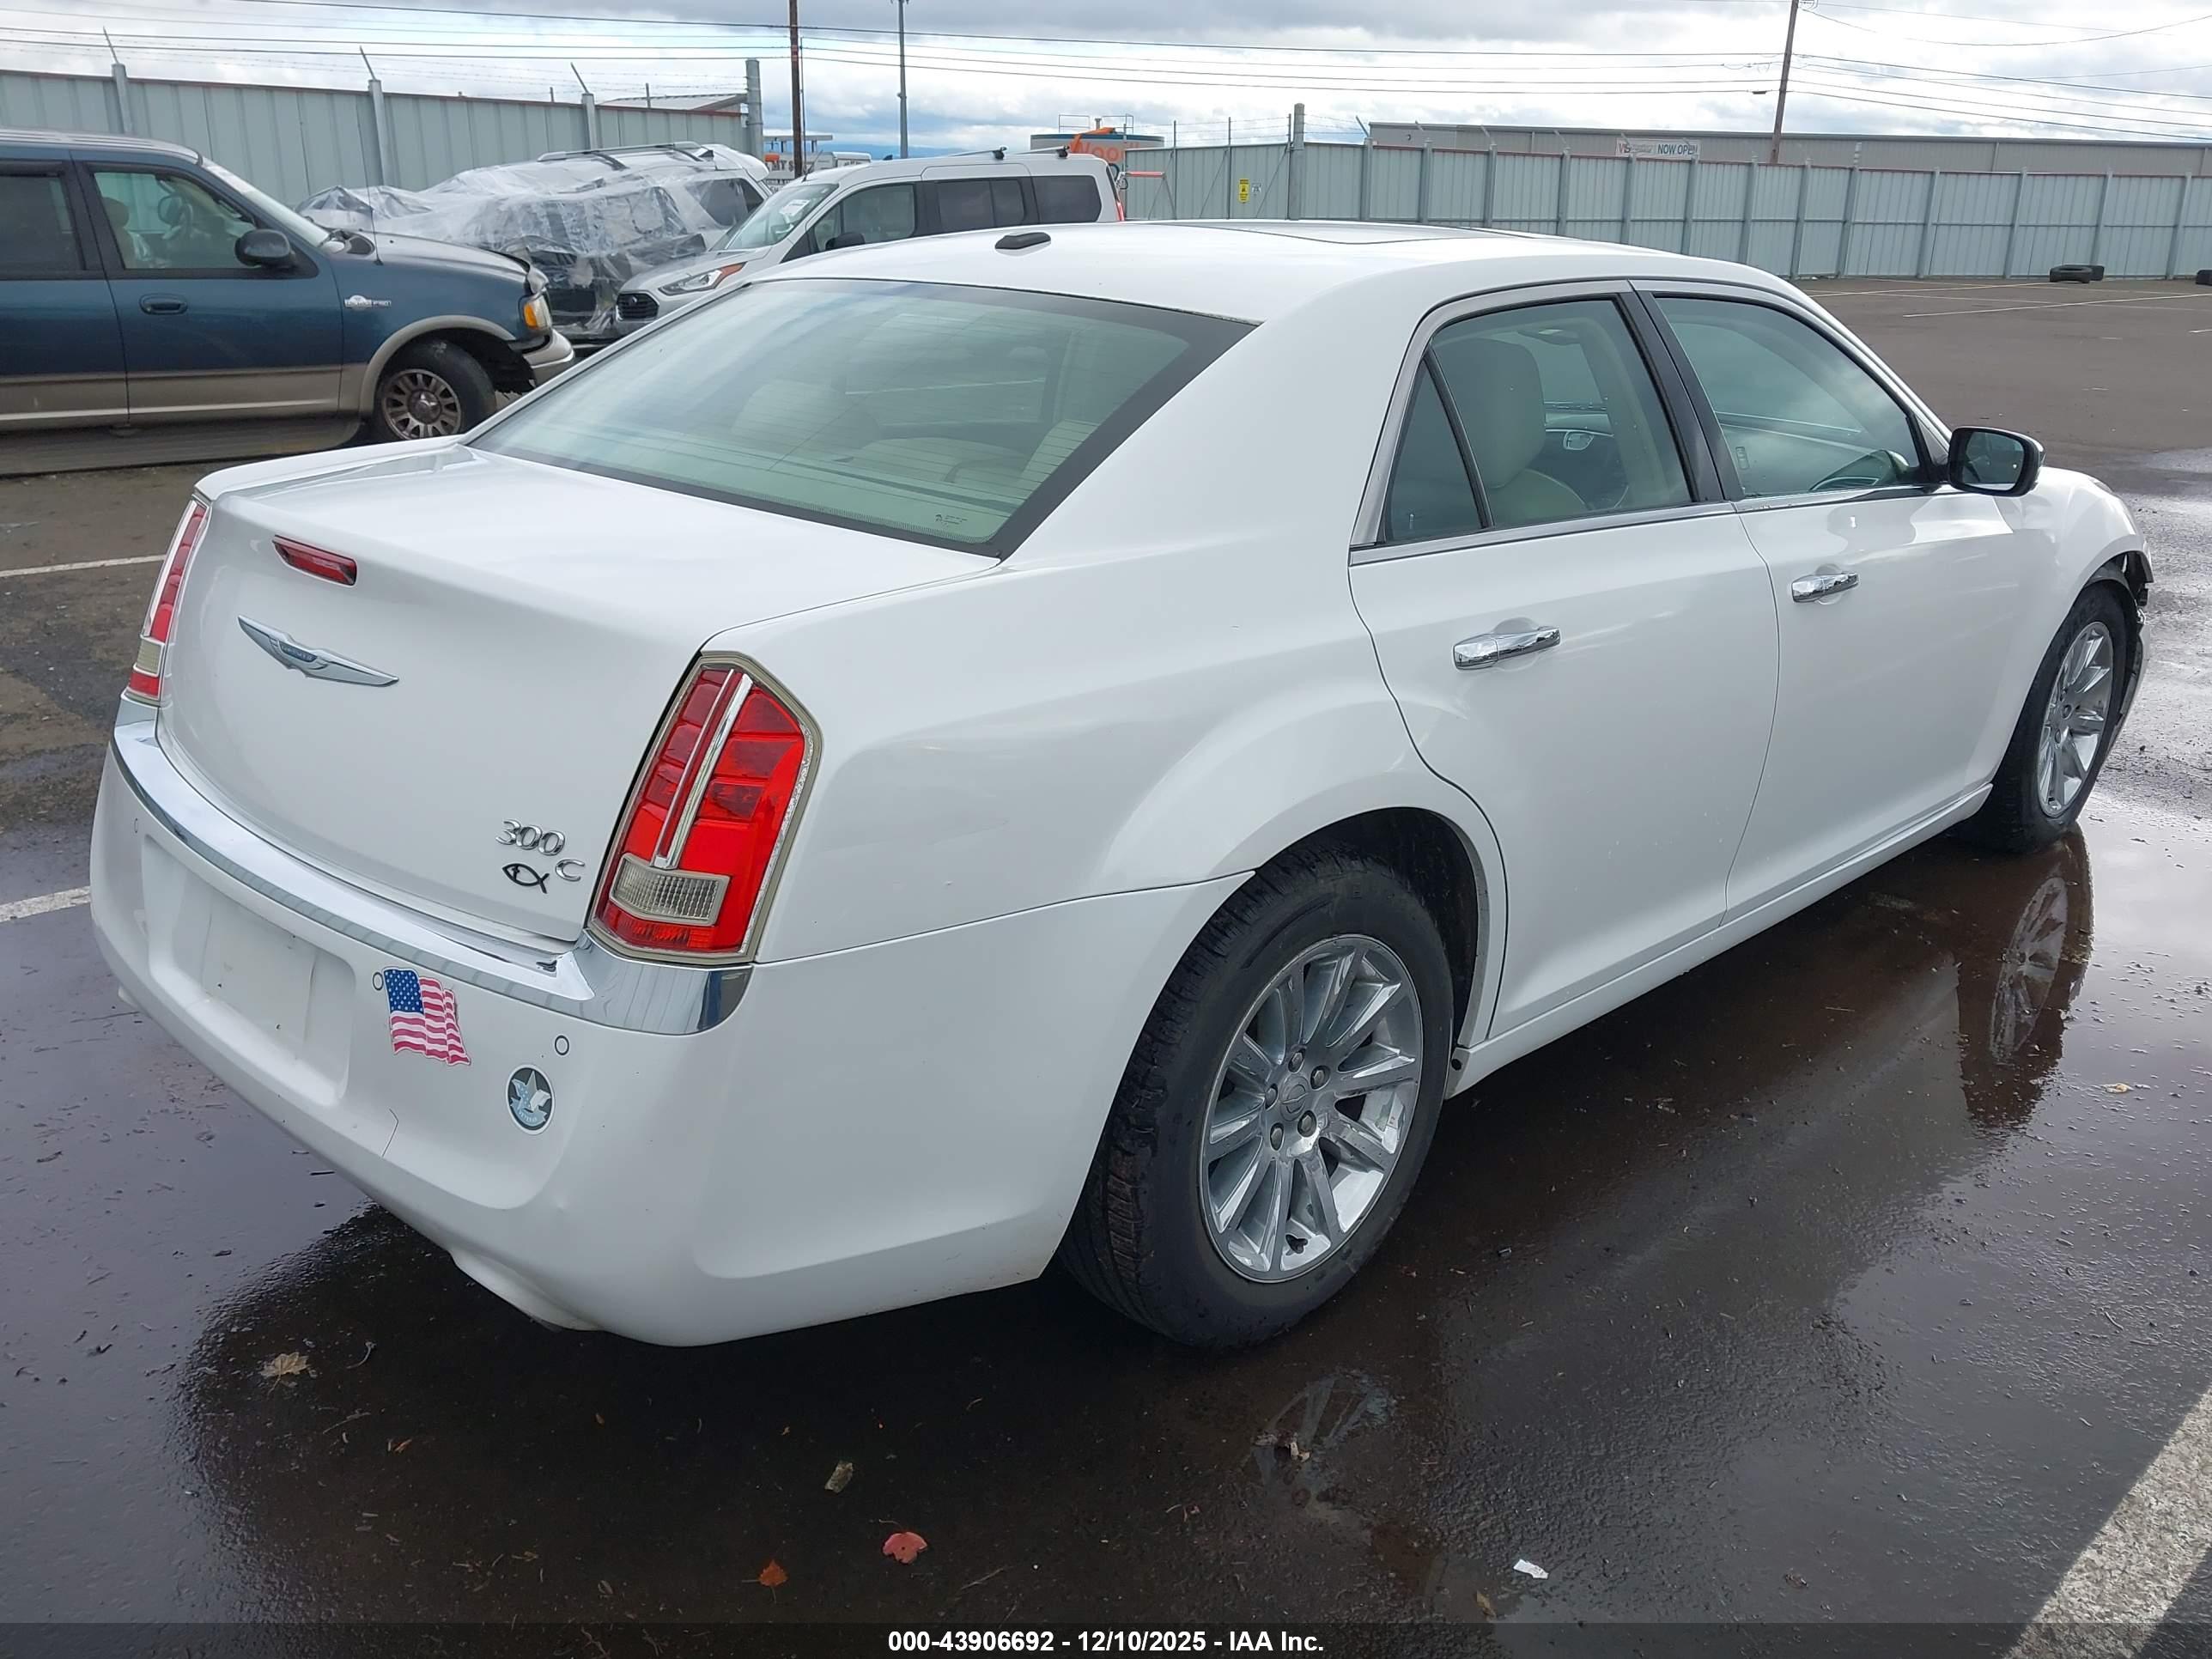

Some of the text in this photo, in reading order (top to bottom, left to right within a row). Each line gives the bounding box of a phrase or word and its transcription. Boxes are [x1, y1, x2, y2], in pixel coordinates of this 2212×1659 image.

[1658, 144, 1677, 155] NOW
[495, 819, 566, 856] 300
[555, 859, 586, 882] C
